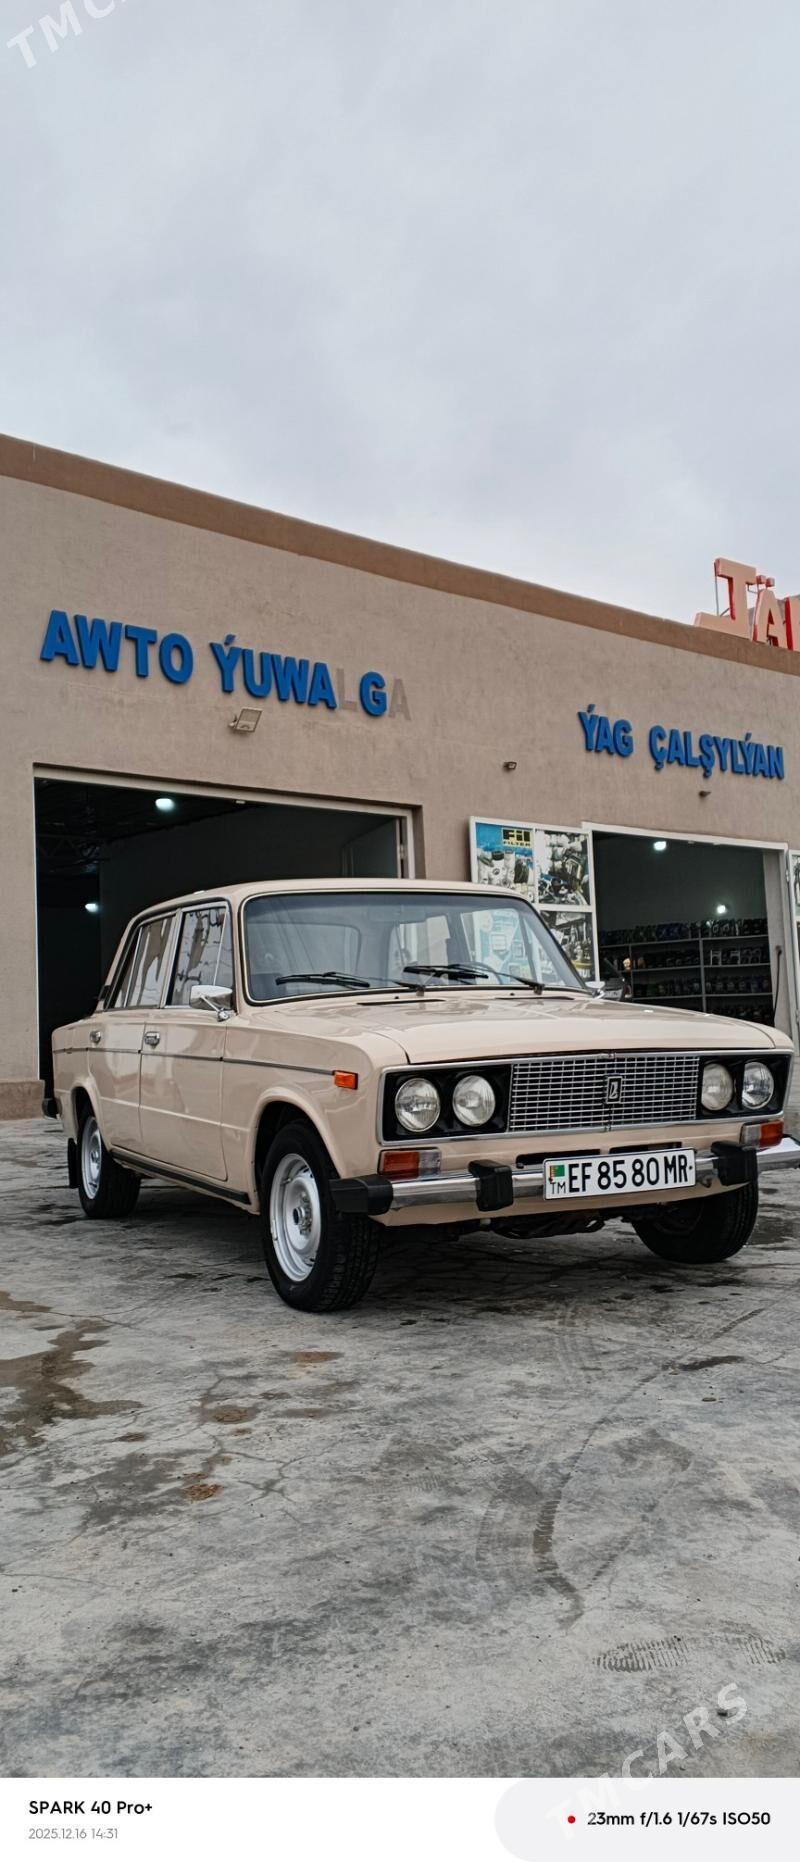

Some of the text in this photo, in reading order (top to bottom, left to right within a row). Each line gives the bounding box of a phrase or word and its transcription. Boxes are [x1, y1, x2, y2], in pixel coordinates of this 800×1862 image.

[40, 609, 194, 685] AWTO
[577, 703, 634, 757] ÝAG
[550, 1181, 567, 1195] TM
[568, 1154, 688, 1193] EF 85 80 MR
